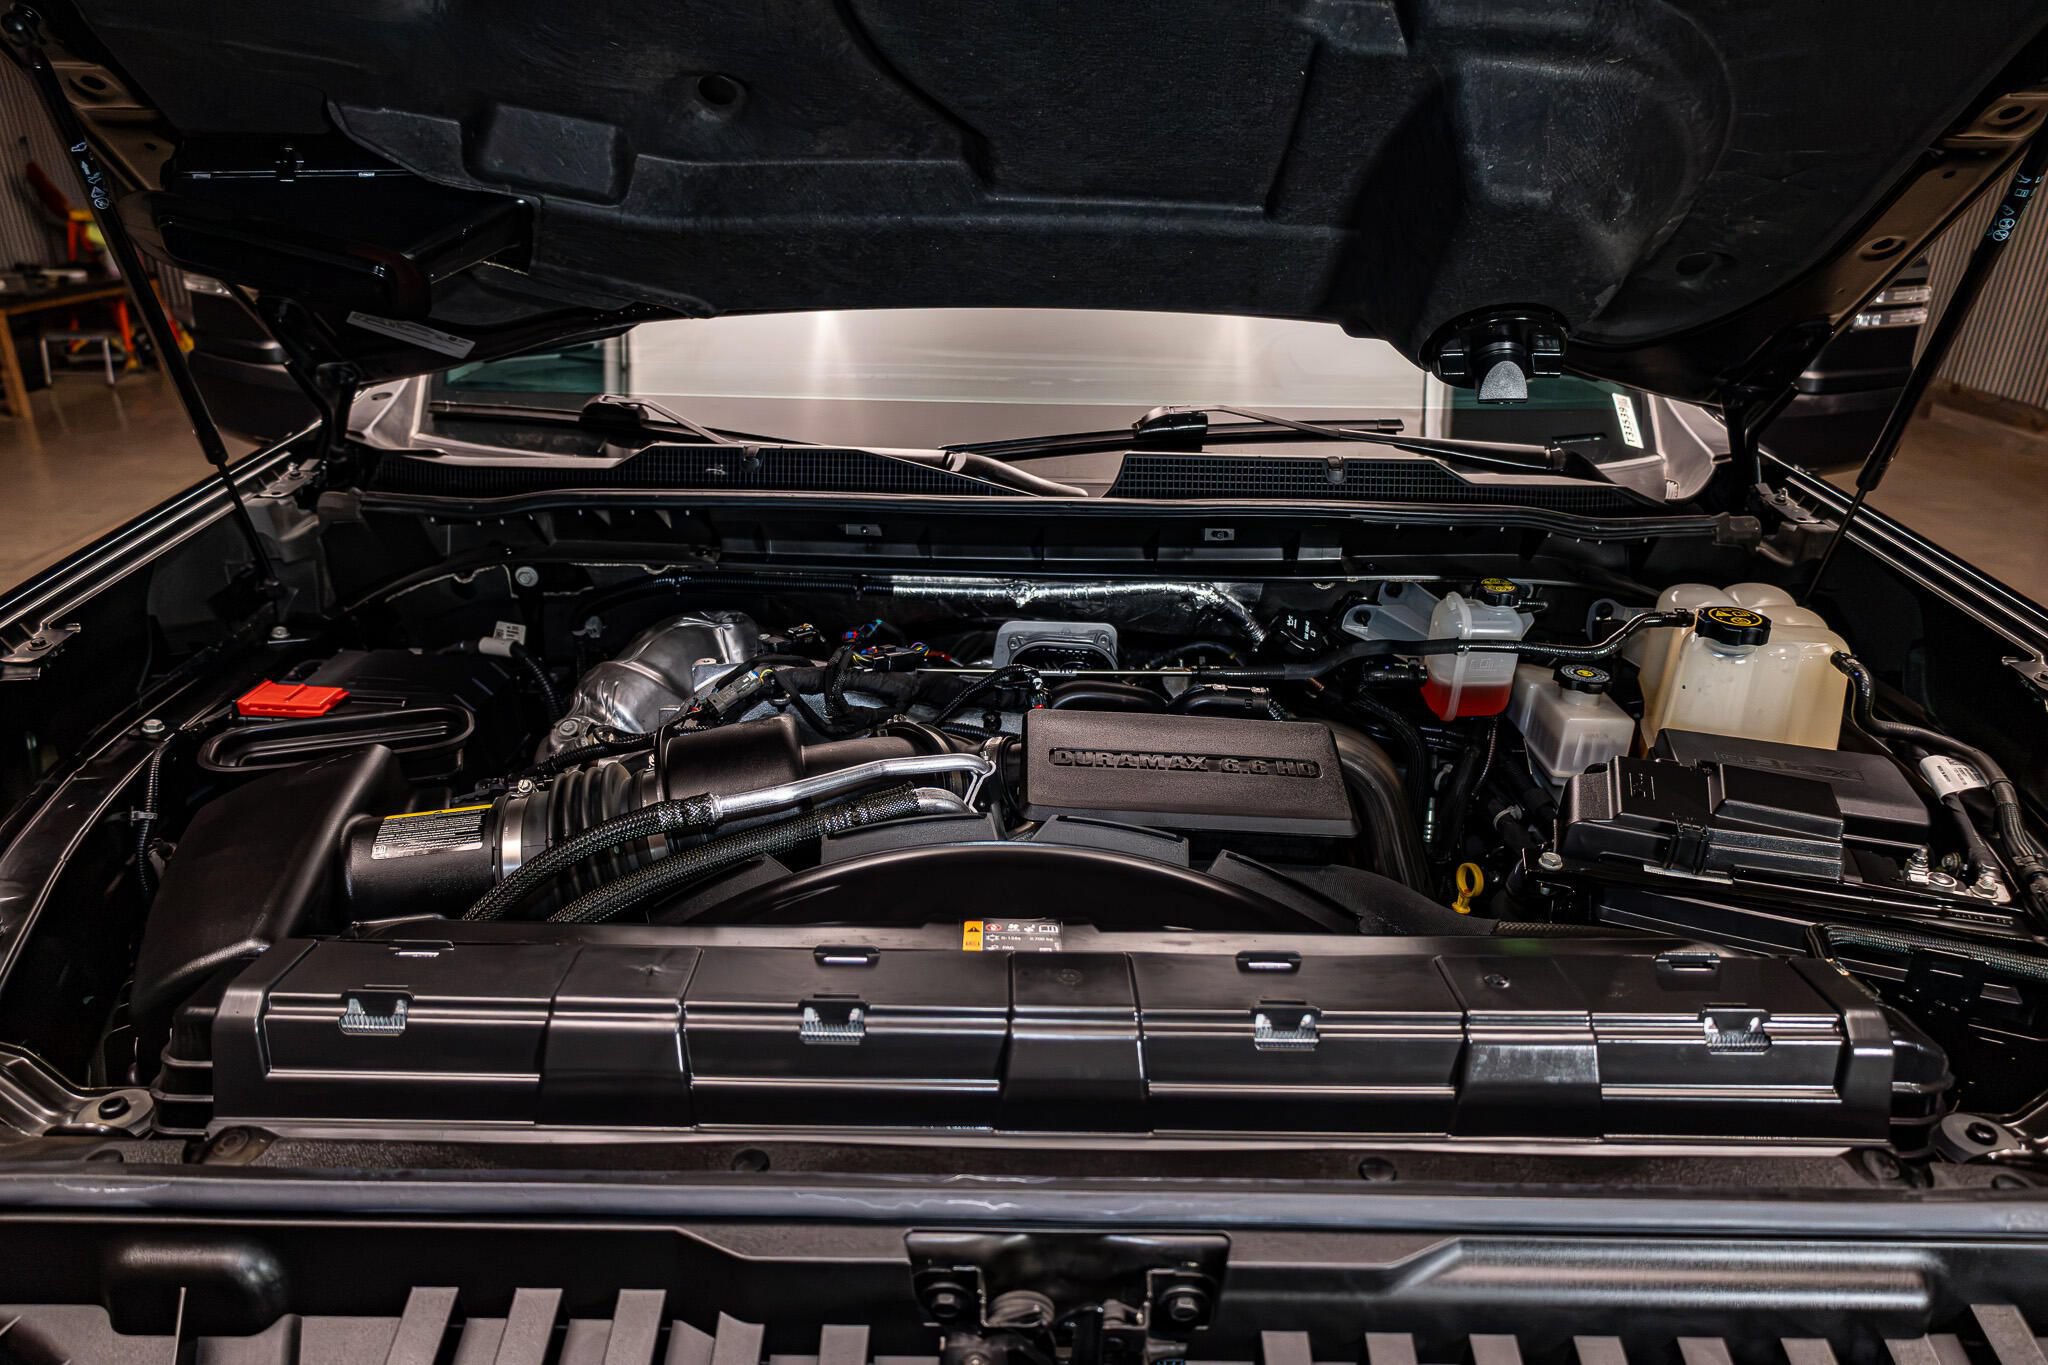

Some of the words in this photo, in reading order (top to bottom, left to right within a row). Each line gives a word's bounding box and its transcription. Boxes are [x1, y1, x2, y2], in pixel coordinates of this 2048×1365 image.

[1054, 750, 1208, 771] DURAMAX
[1221, 758, 1269, 774] 6.6
[1276, 760, 1318, 777] HD
